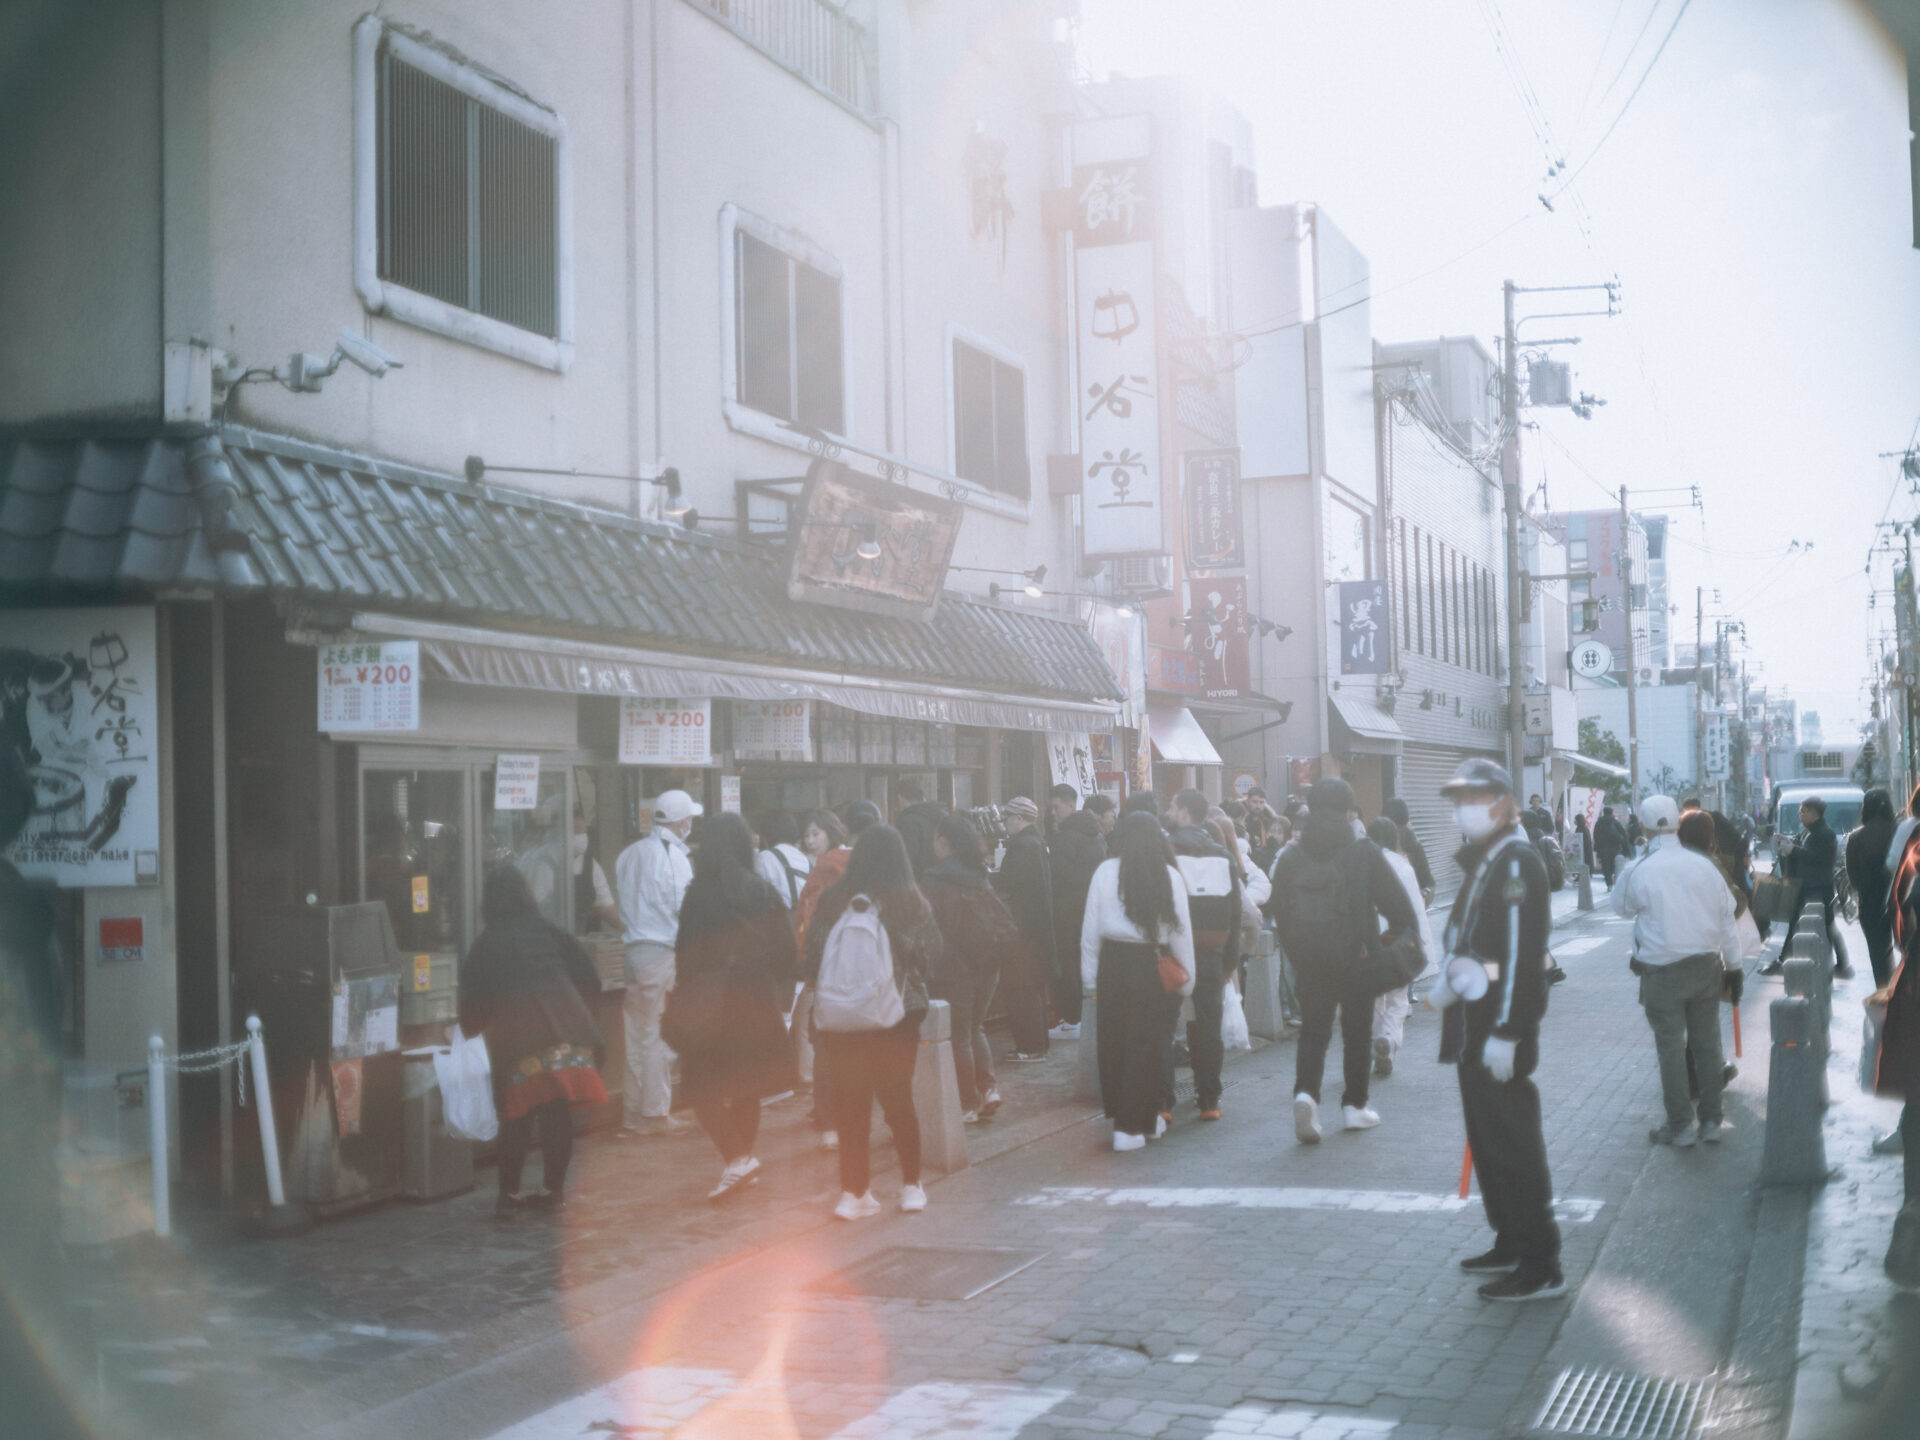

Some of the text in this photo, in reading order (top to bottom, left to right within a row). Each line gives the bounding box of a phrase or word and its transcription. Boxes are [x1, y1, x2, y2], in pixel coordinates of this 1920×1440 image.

[1079, 168, 1144, 236] 餅
[1085, 288, 1154, 509] 中谷堂
[1349, 599, 1378, 662] 黒川
[323, 645, 381, 665] よもぎ餅
[356, 664, 411, 685] ¥200
[89, 631, 148, 765] 中谷堂
[1207, 688, 1239, 698] HIYORI
[656, 711, 704, 727] ¥200
[100, 849, 129, 861] make
